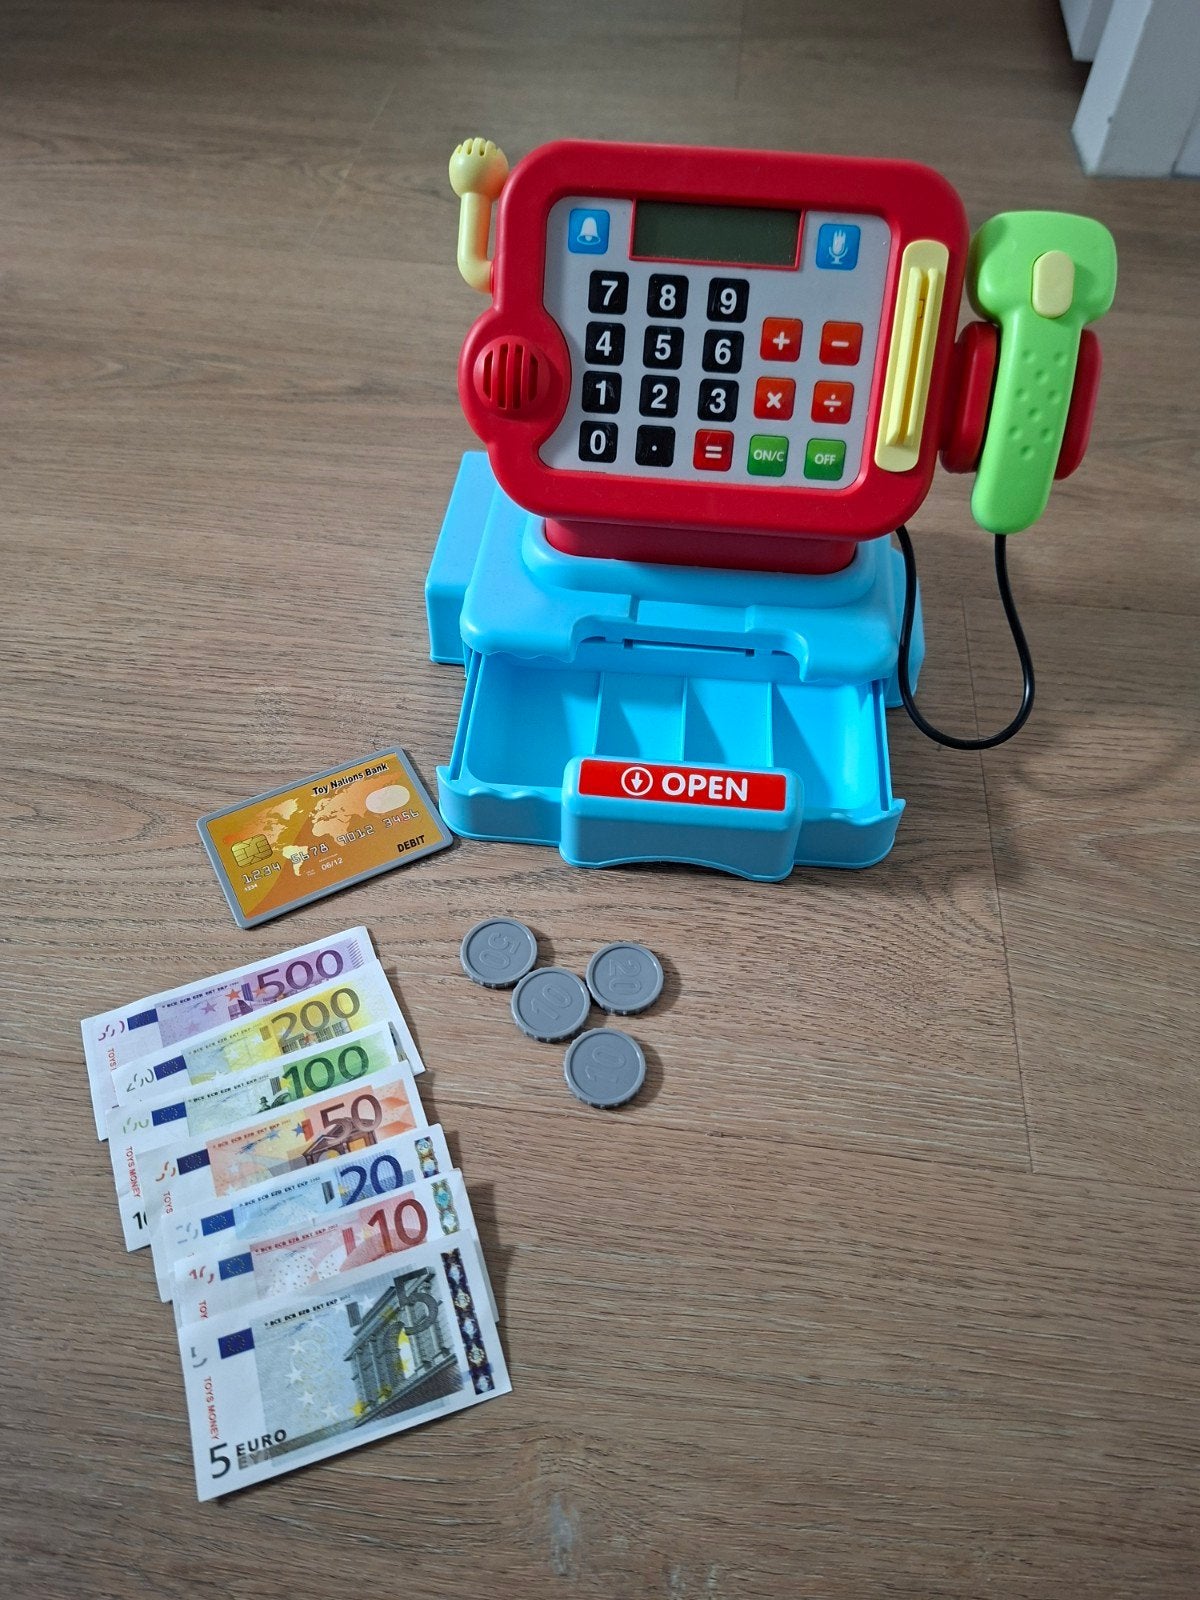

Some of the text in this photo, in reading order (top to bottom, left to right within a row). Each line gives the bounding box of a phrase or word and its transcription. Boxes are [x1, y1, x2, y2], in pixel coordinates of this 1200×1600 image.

[601, 280, 737, 315] 7 8 9
[596, 331, 731, 365] 4 5 6
[596, 380, 726, 413] 1 2 3
[590, 430, 606, 455] 0
[753, 450, 784, 462] ON/C
[814, 454, 836, 465] OFF
[312, 763, 388, 796] Toy Nations Bank
[661, 772, 748, 802] OPEN
[242, 862, 281, 884] 1234
[290, 844, 329, 864] 5678
[337, 825, 375, 844] 9012
[382, 809, 419, 827] 3456
[397, 835, 425, 852] DEBIT
[257, 949, 344, 1001] 500
[271, 988, 360, 1042] 200
[108, 1048, 117, 1068] TOYS
[282, 1045, 369, 1100] 100
[320, 1094, 382, 1138] 50
[125, 1146, 136, 1166] TOYS
[128, 1167, 141, 1198] MONEY
[339, 1154, 403, 1208] 20
[162, 1191, 174, 1214] TOYS
[367, 1198, 428, 1253] 10
[204, 1376, 220, 1440] TOYS MONEY
[209, 1429, 287, 1479] 5 EURO
